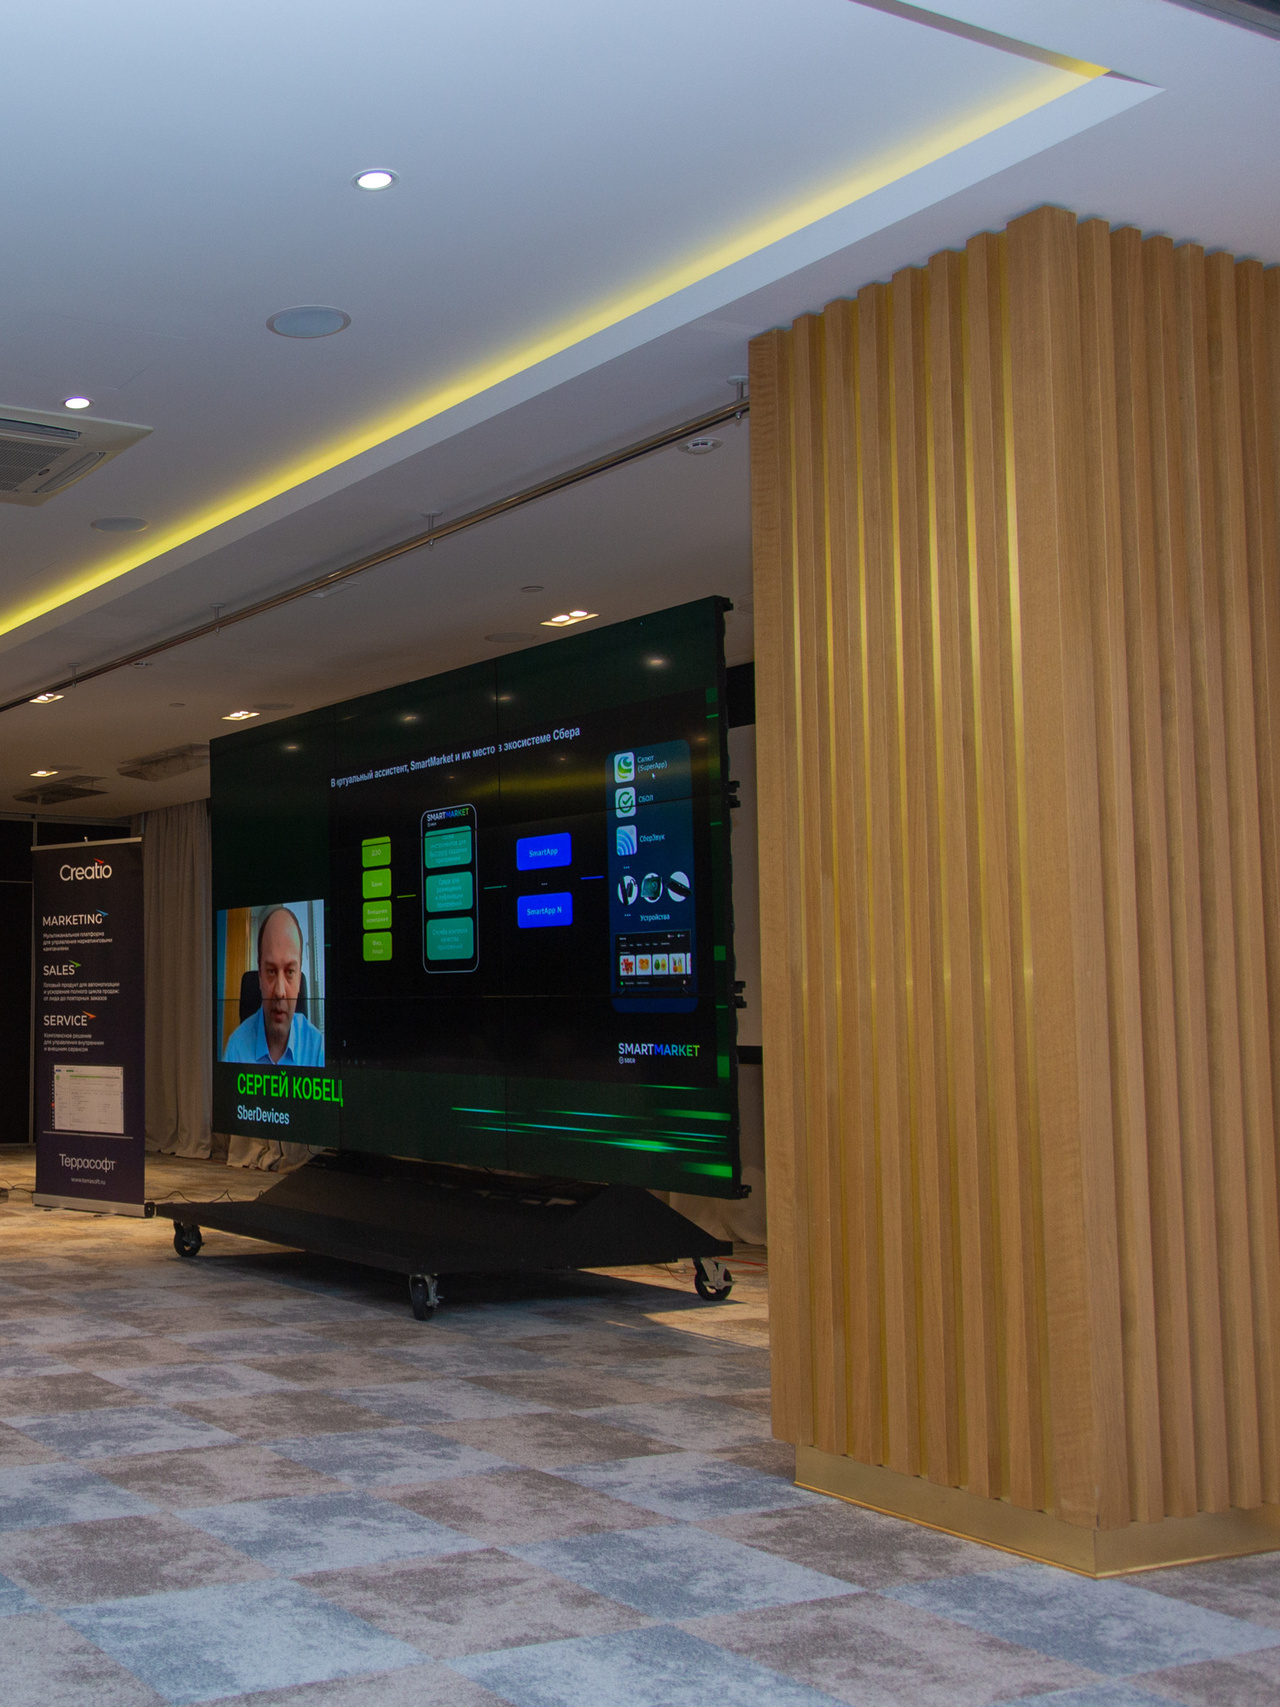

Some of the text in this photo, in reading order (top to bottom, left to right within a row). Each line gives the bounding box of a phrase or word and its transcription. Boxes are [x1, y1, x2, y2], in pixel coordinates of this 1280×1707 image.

[374, 764, 409, 779] ассистент,
[410, 752, 454, 771] SmartMarket
[455, 753, 460, 761] и
[461, 750, 471, 760] их
[472, 745, 496, 758] место
[503, 733, 551, 751] экосистеме
[552, 727, 580, 740] Сбера
[426, 807, 470, 821] SMARTMARKET
[529, 848, 558, 858] SmartApp
[59, 860, 112, 882] Creatio
[526, 907, 556, 916] SmartApp
[640, 913, 671, 922] Устройства
[42, 912, 103, 927] MARKETING
[43, 964, 75, 976] SALES
[43, 1015, 88, 1027] SERVICE
[618, 1042, 700, 1057] SMARTMARKET
[237, 1070, 344, 1108] СЕРГЕЙ КОБЕЦ
[237, 1104, 290, 1125] SberDevices
[59, 1154, 116, 1173] Террасофт
